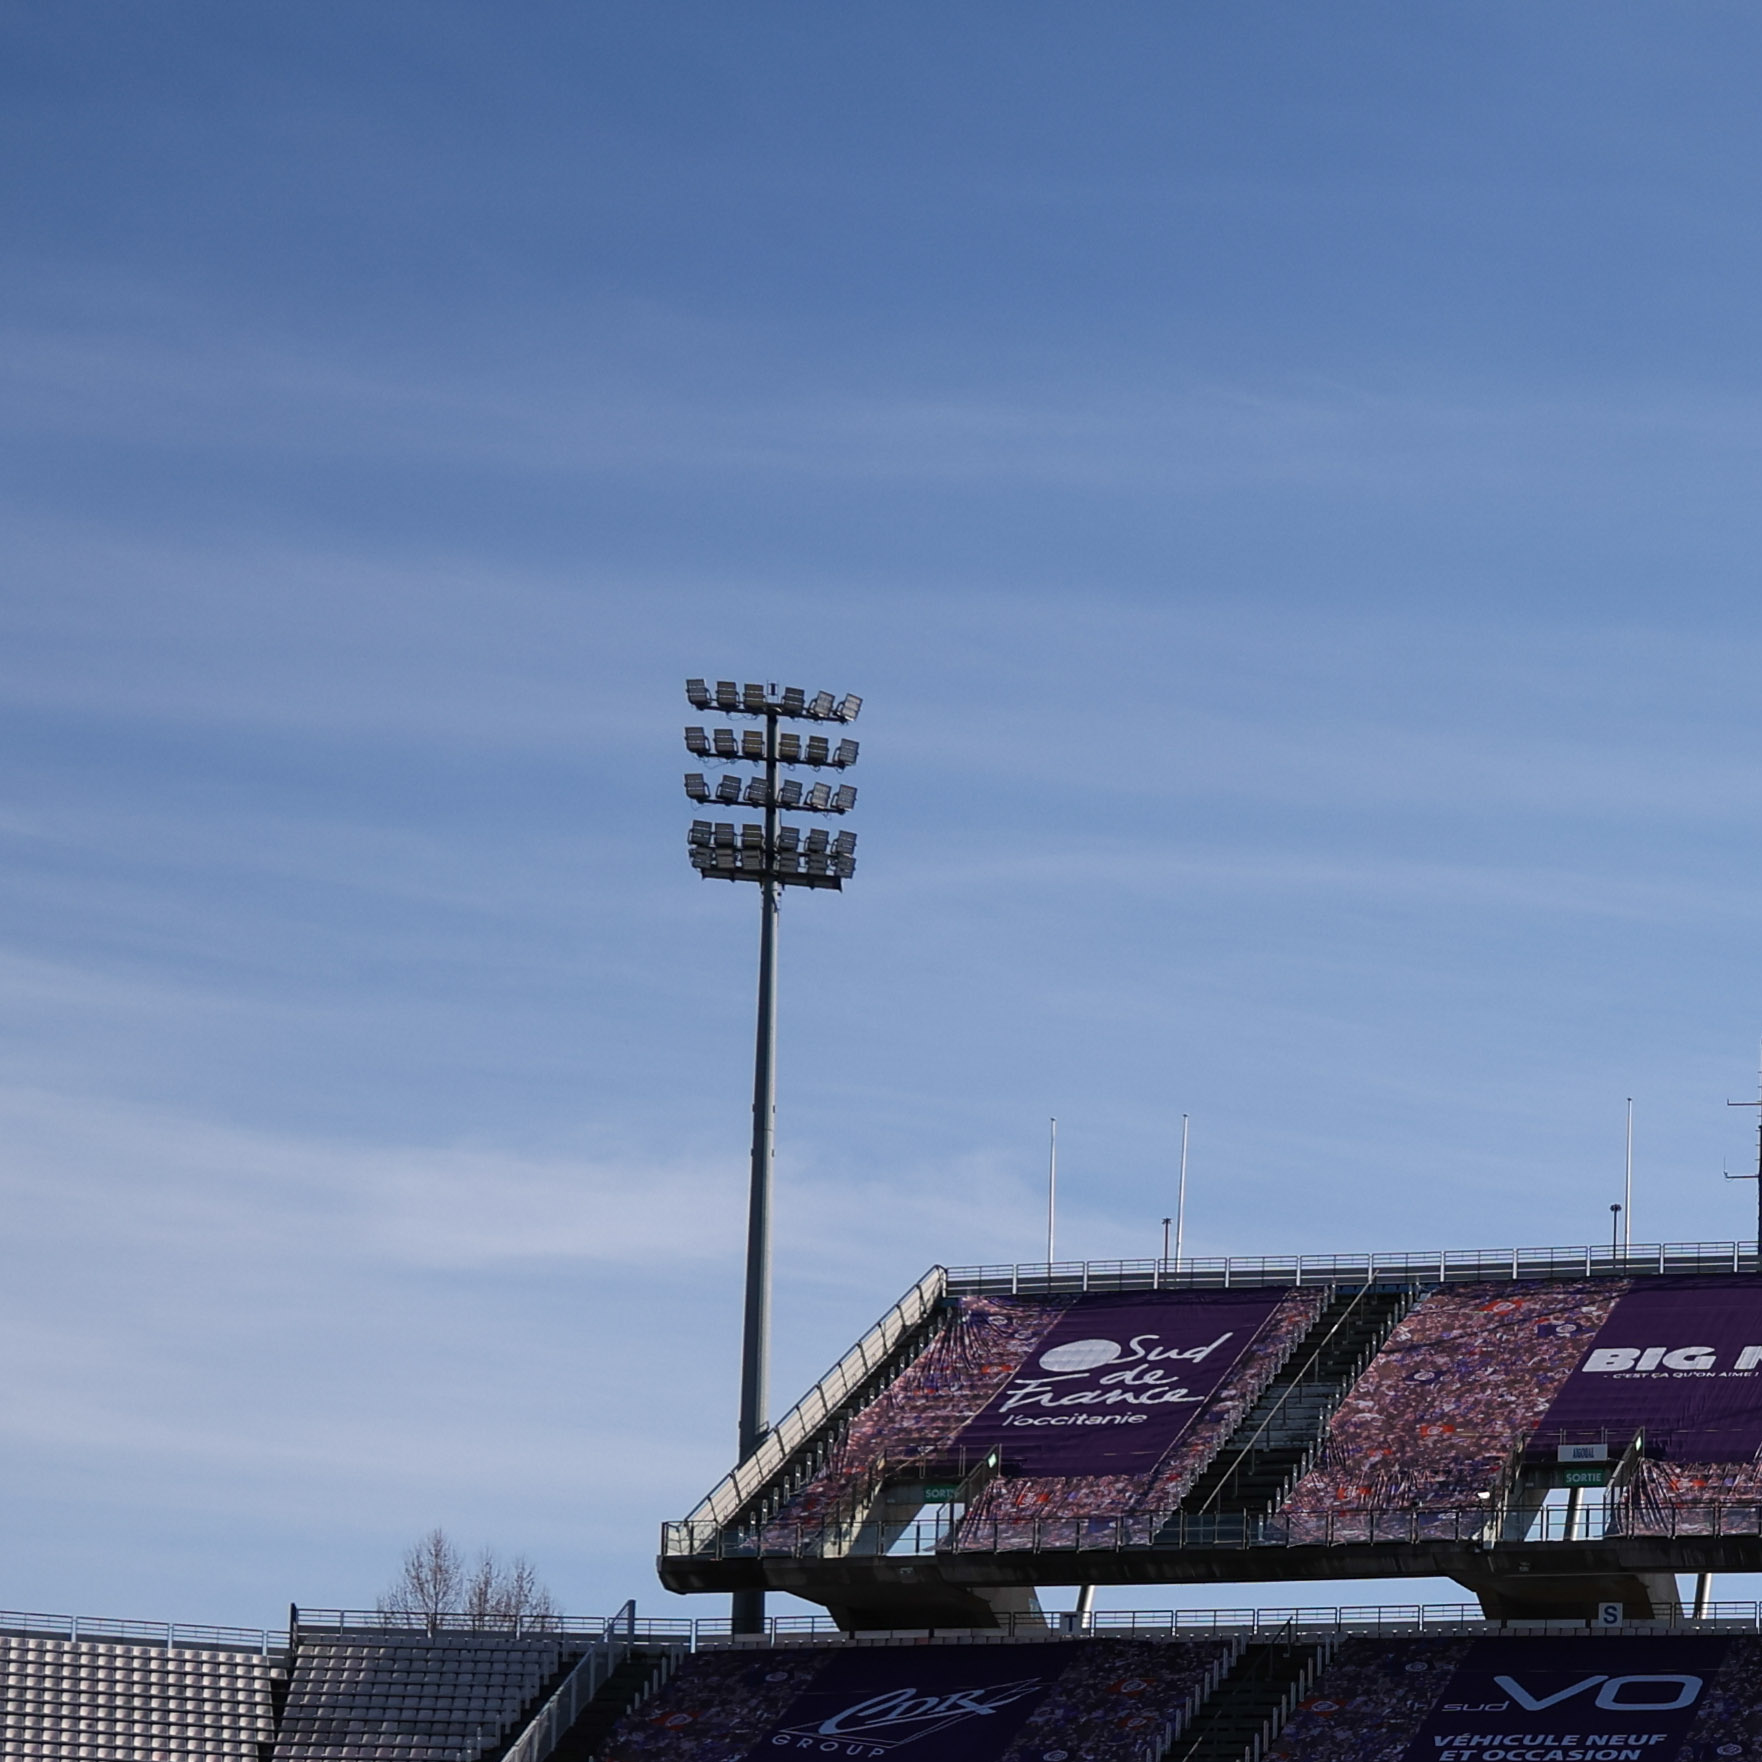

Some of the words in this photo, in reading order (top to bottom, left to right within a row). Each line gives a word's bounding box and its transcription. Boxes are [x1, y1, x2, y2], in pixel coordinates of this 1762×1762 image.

[1106, 1332, 1234, 1364] Sud
[1582, 1347, 1717, 1372] BIG
[1099, 1364, 1180, 1385] de
[1672, 1371, 1716, 1379] QU'ON
[1000, 1373, 1206, 1413] France
[1002, 1411, 1149, 1427] l'occitanie
[1566, 1472, 1603, 1482] SORTIE
[1063, 1614, 1078, 1632] T
[1603, 1605, 1618, 1624] S
[1441, 1700, 1512, 1712] sud
[1493, 1675, 1704, 1711] VO
[772, 1734, 885, 1758] GROUP
[1432, 1732, 1581, 1747] VÉHICULE
[1584, 1733, 1669, 1747] NEUF
[1438, 1749, 1478, 1762] ET
[1481, 1749, 1642, 1762] OCCASION
